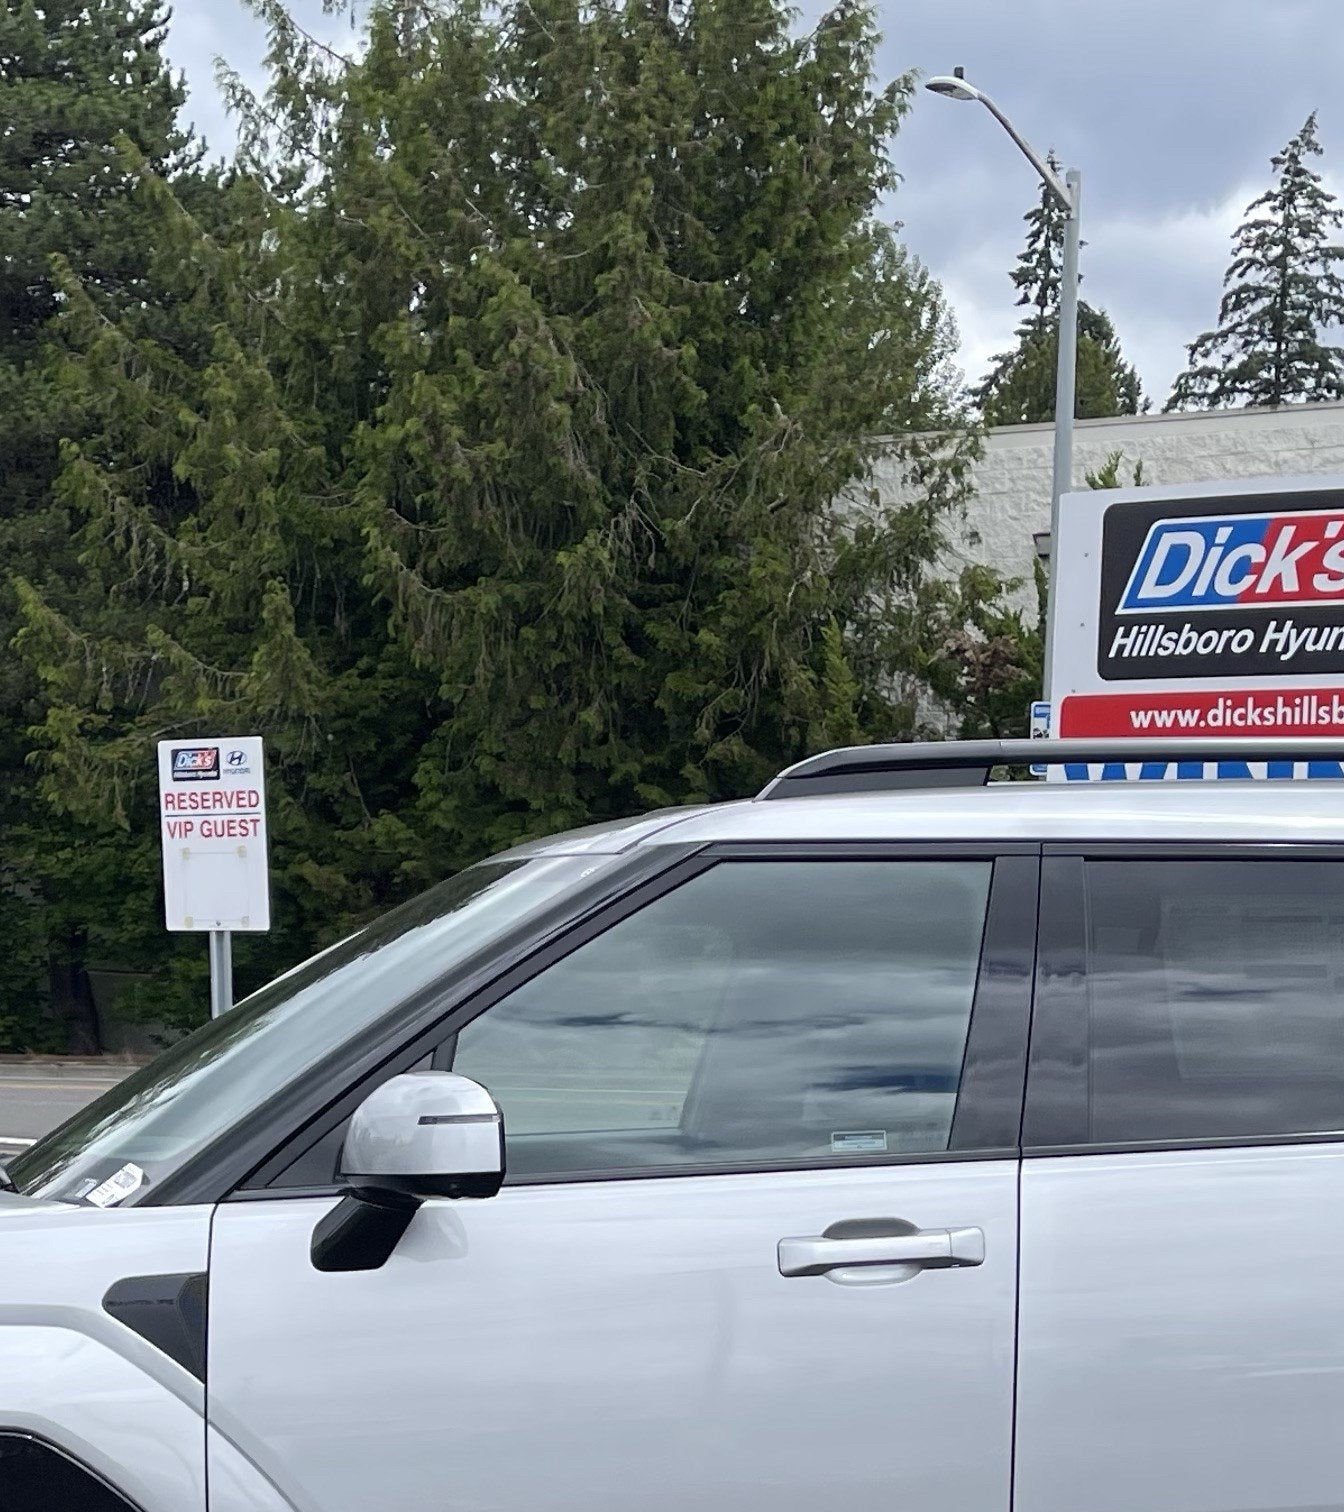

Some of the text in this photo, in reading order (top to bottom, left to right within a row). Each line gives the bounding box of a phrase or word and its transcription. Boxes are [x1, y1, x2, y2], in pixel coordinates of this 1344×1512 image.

[1108, 623, 1255, 658] Hillsboro
[164, 790, 260, 810] RESERVED
[166, 819, 261, 839] VIP GUEST
